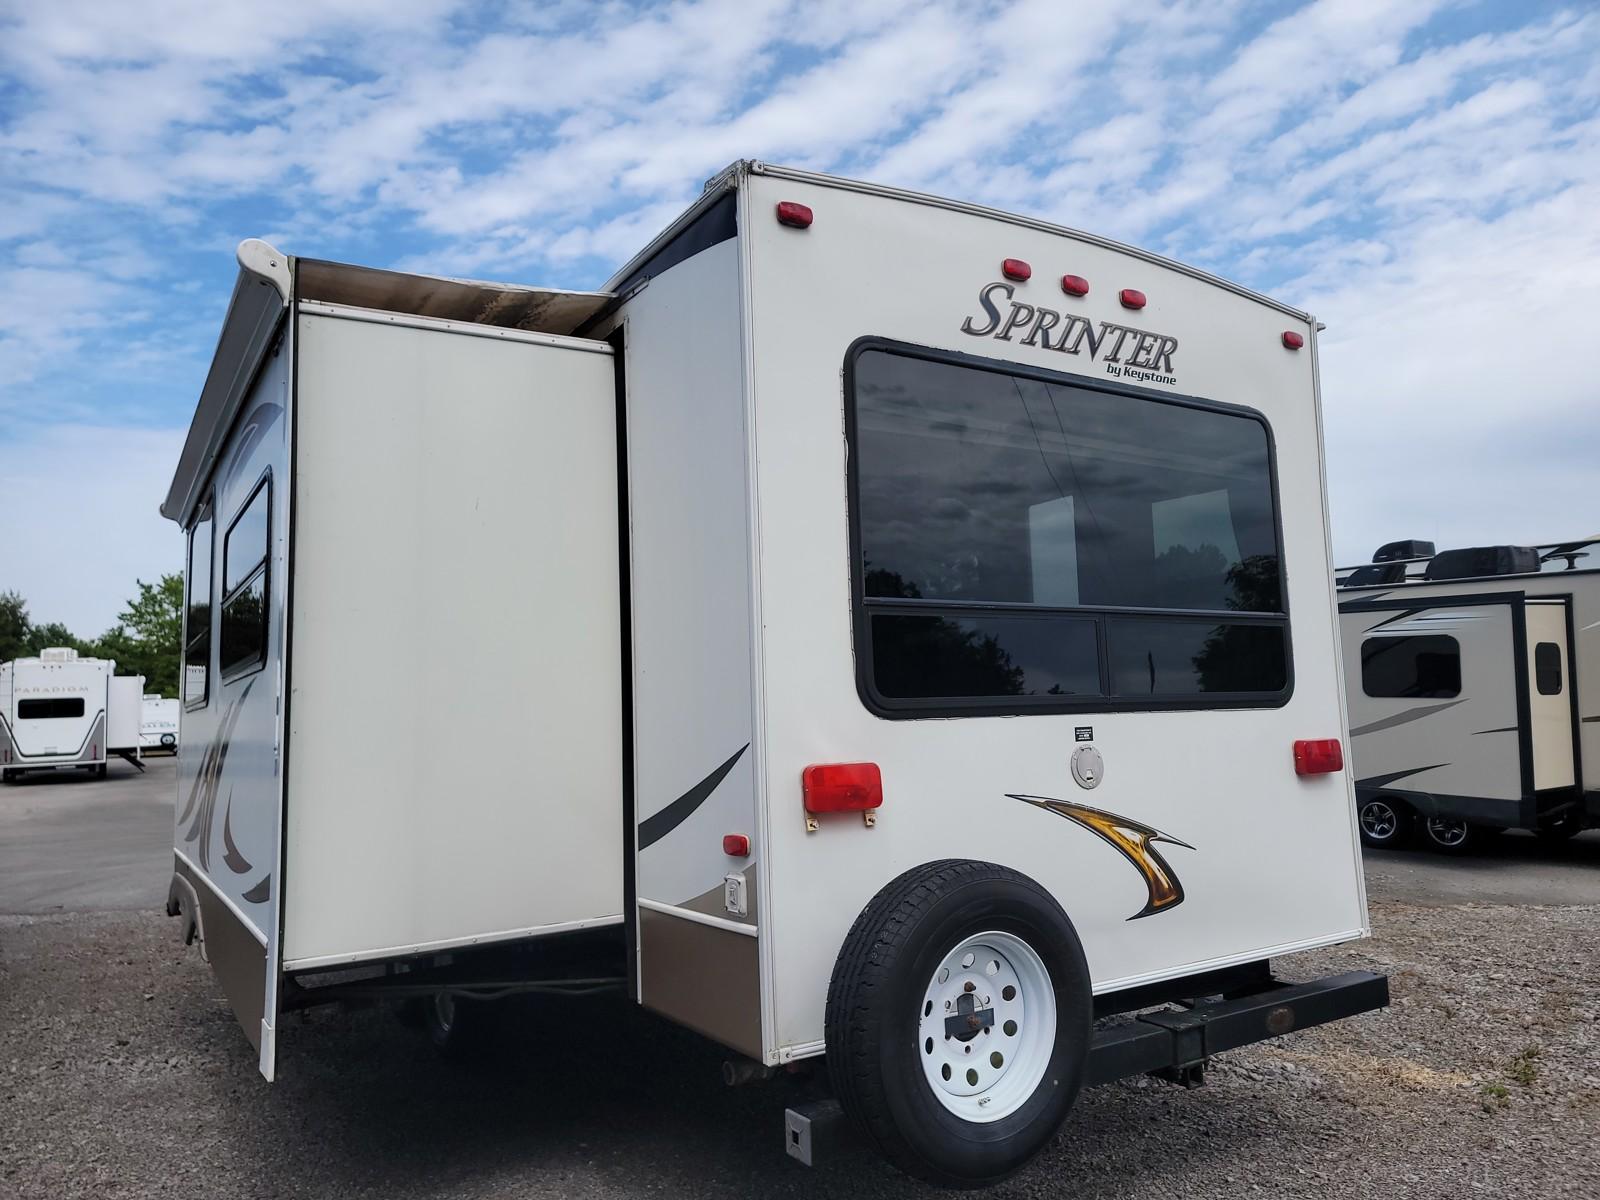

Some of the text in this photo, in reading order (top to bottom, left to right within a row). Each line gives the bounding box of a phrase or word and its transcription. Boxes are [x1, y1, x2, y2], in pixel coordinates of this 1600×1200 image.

[960, 281, 1178, 374] SPRINTER
[1106, 363, 1177, 386] by Keystone
